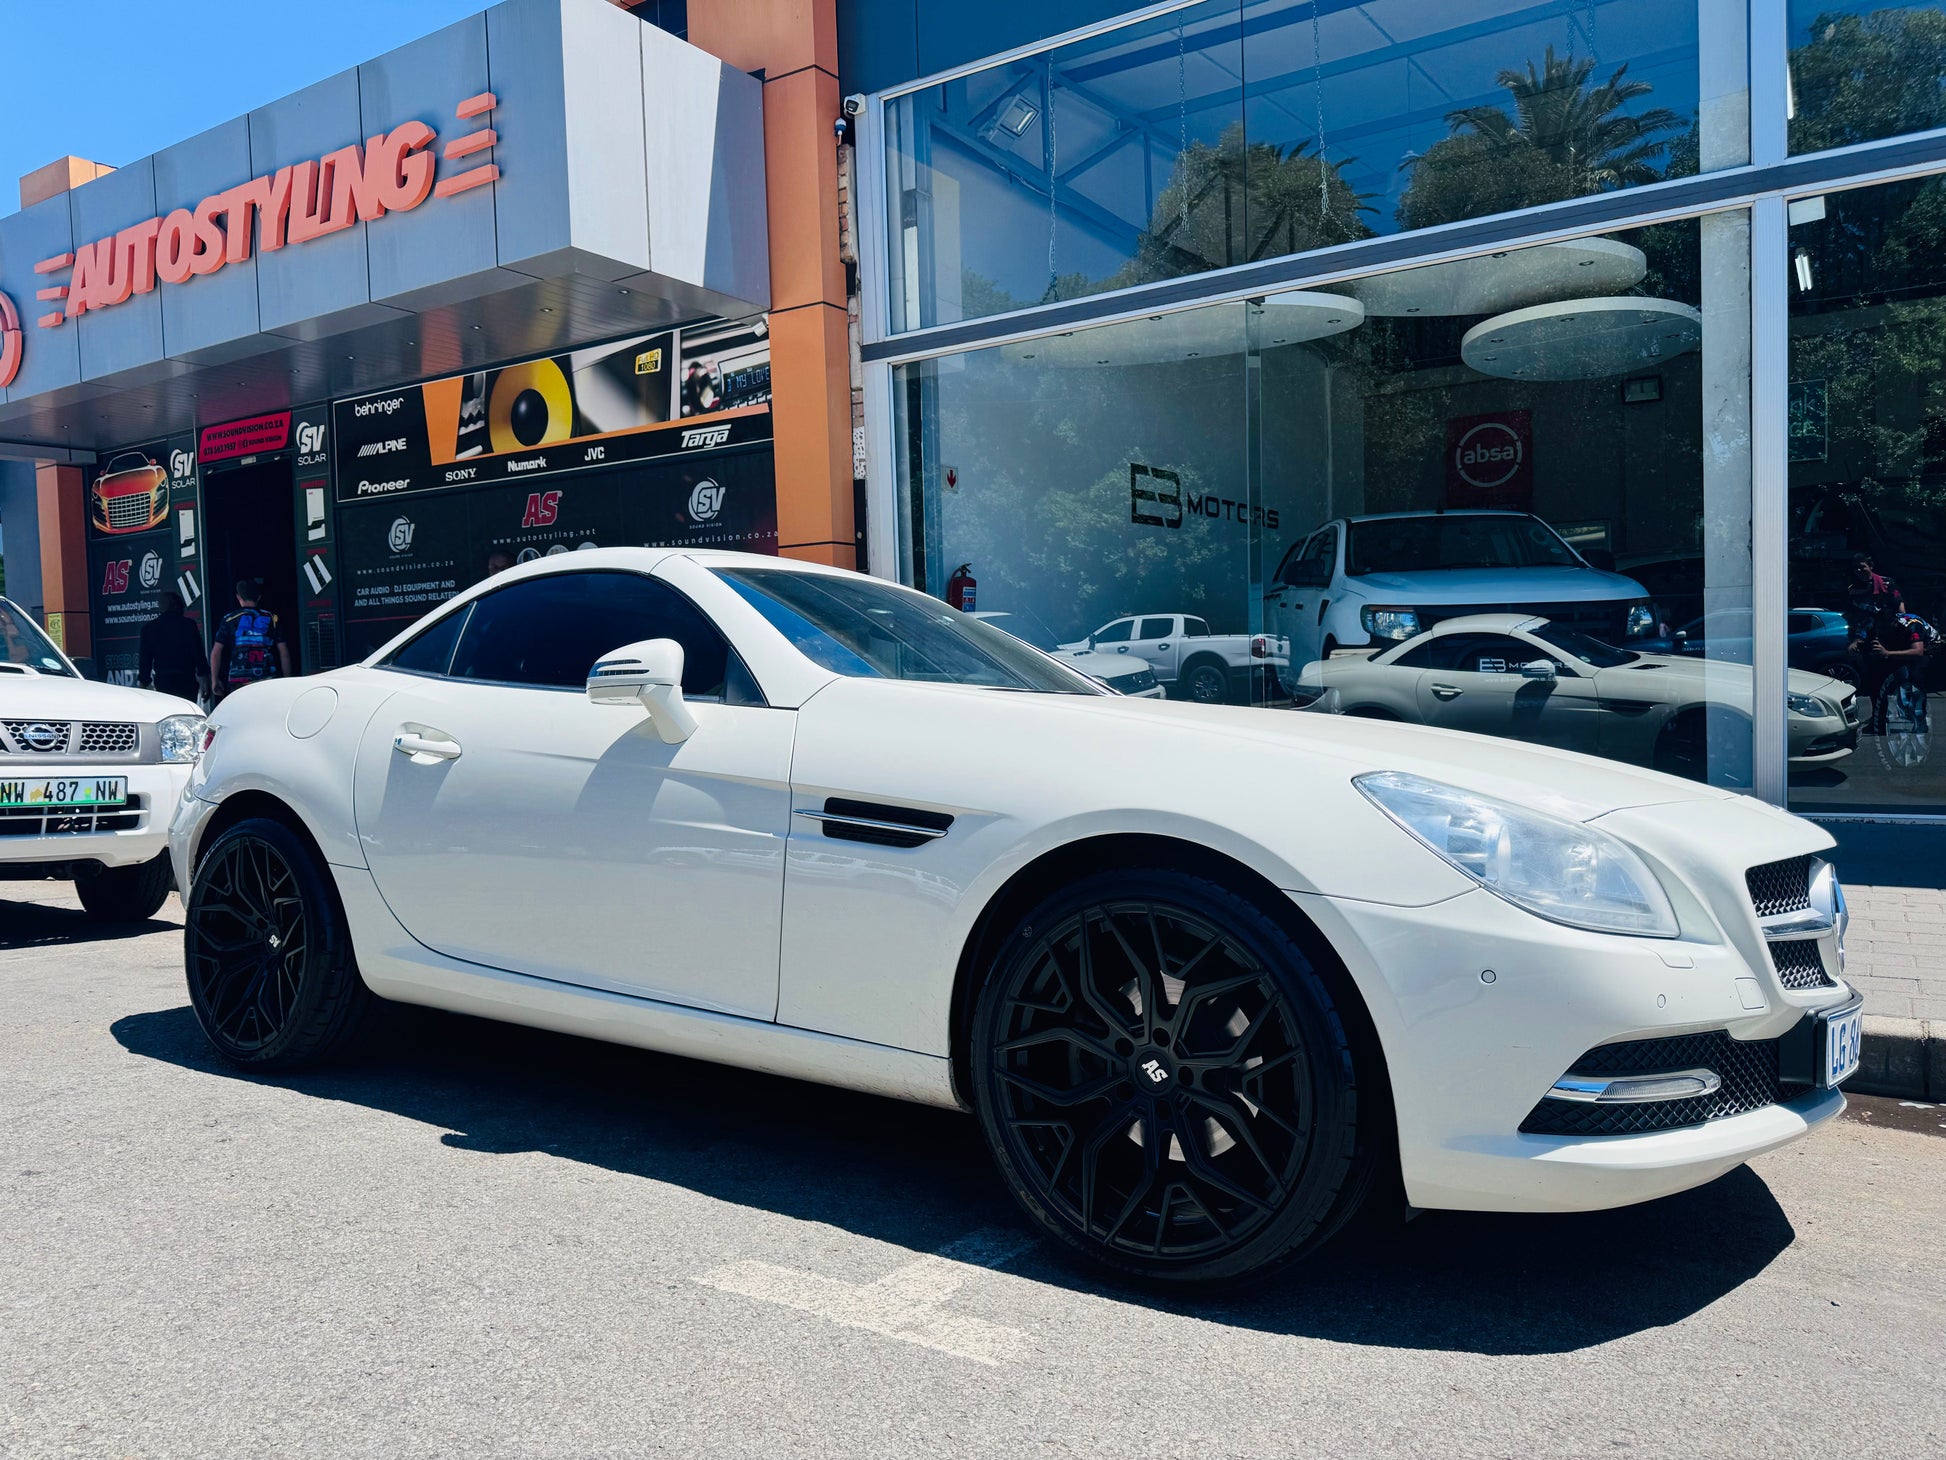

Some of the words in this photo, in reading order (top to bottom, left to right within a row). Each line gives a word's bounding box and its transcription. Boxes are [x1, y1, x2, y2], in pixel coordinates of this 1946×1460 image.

[65, 121, 437, 317] AUTOSTYLING
[355, 398, 404, 417] behringer
[681, 424, 732, 448] Targa
[297, 453, 327, 466] SOLAR
[584, 447, 605, 462] JVC
[1463, 443, 1515, 465] absa
[507, 456, 547, 472] Numark
[171, 477, 196, 489] SOLAR
[445, 468, 477, 482] SONY
[357, 479, 411, 495] Pioneer
[521, 490, 561, 528] AS
[1187, 491, 1280, 530] MOTORS
[492, 528, 596, 545] www.autostyling.net
[643, 531, 778, 549] www.soundvision.co.za
[102, 559, 130, 595] AS
[356, 587, 370, 596] CAR
[370, 586, 390, 596] AUDIO
[394, 585, 402, 593] DJ
[403, 581, 440, 593] EQUIPMENT
[440, 580, 456, 589] AND
[354, 598, 368, 607] AND
[368, 597, 380, 606] ALL
[381, 595, 404, 606] THINGS
[404, 594, 427, 604] SOUND
[428, 590, 459, 601] RELATED
[1, 781, 25, 803] NW
[43, 781, 79, 803] 487
[95, 780, 119, 802] NW
[1141, 1059, 1169, 1083] AS
